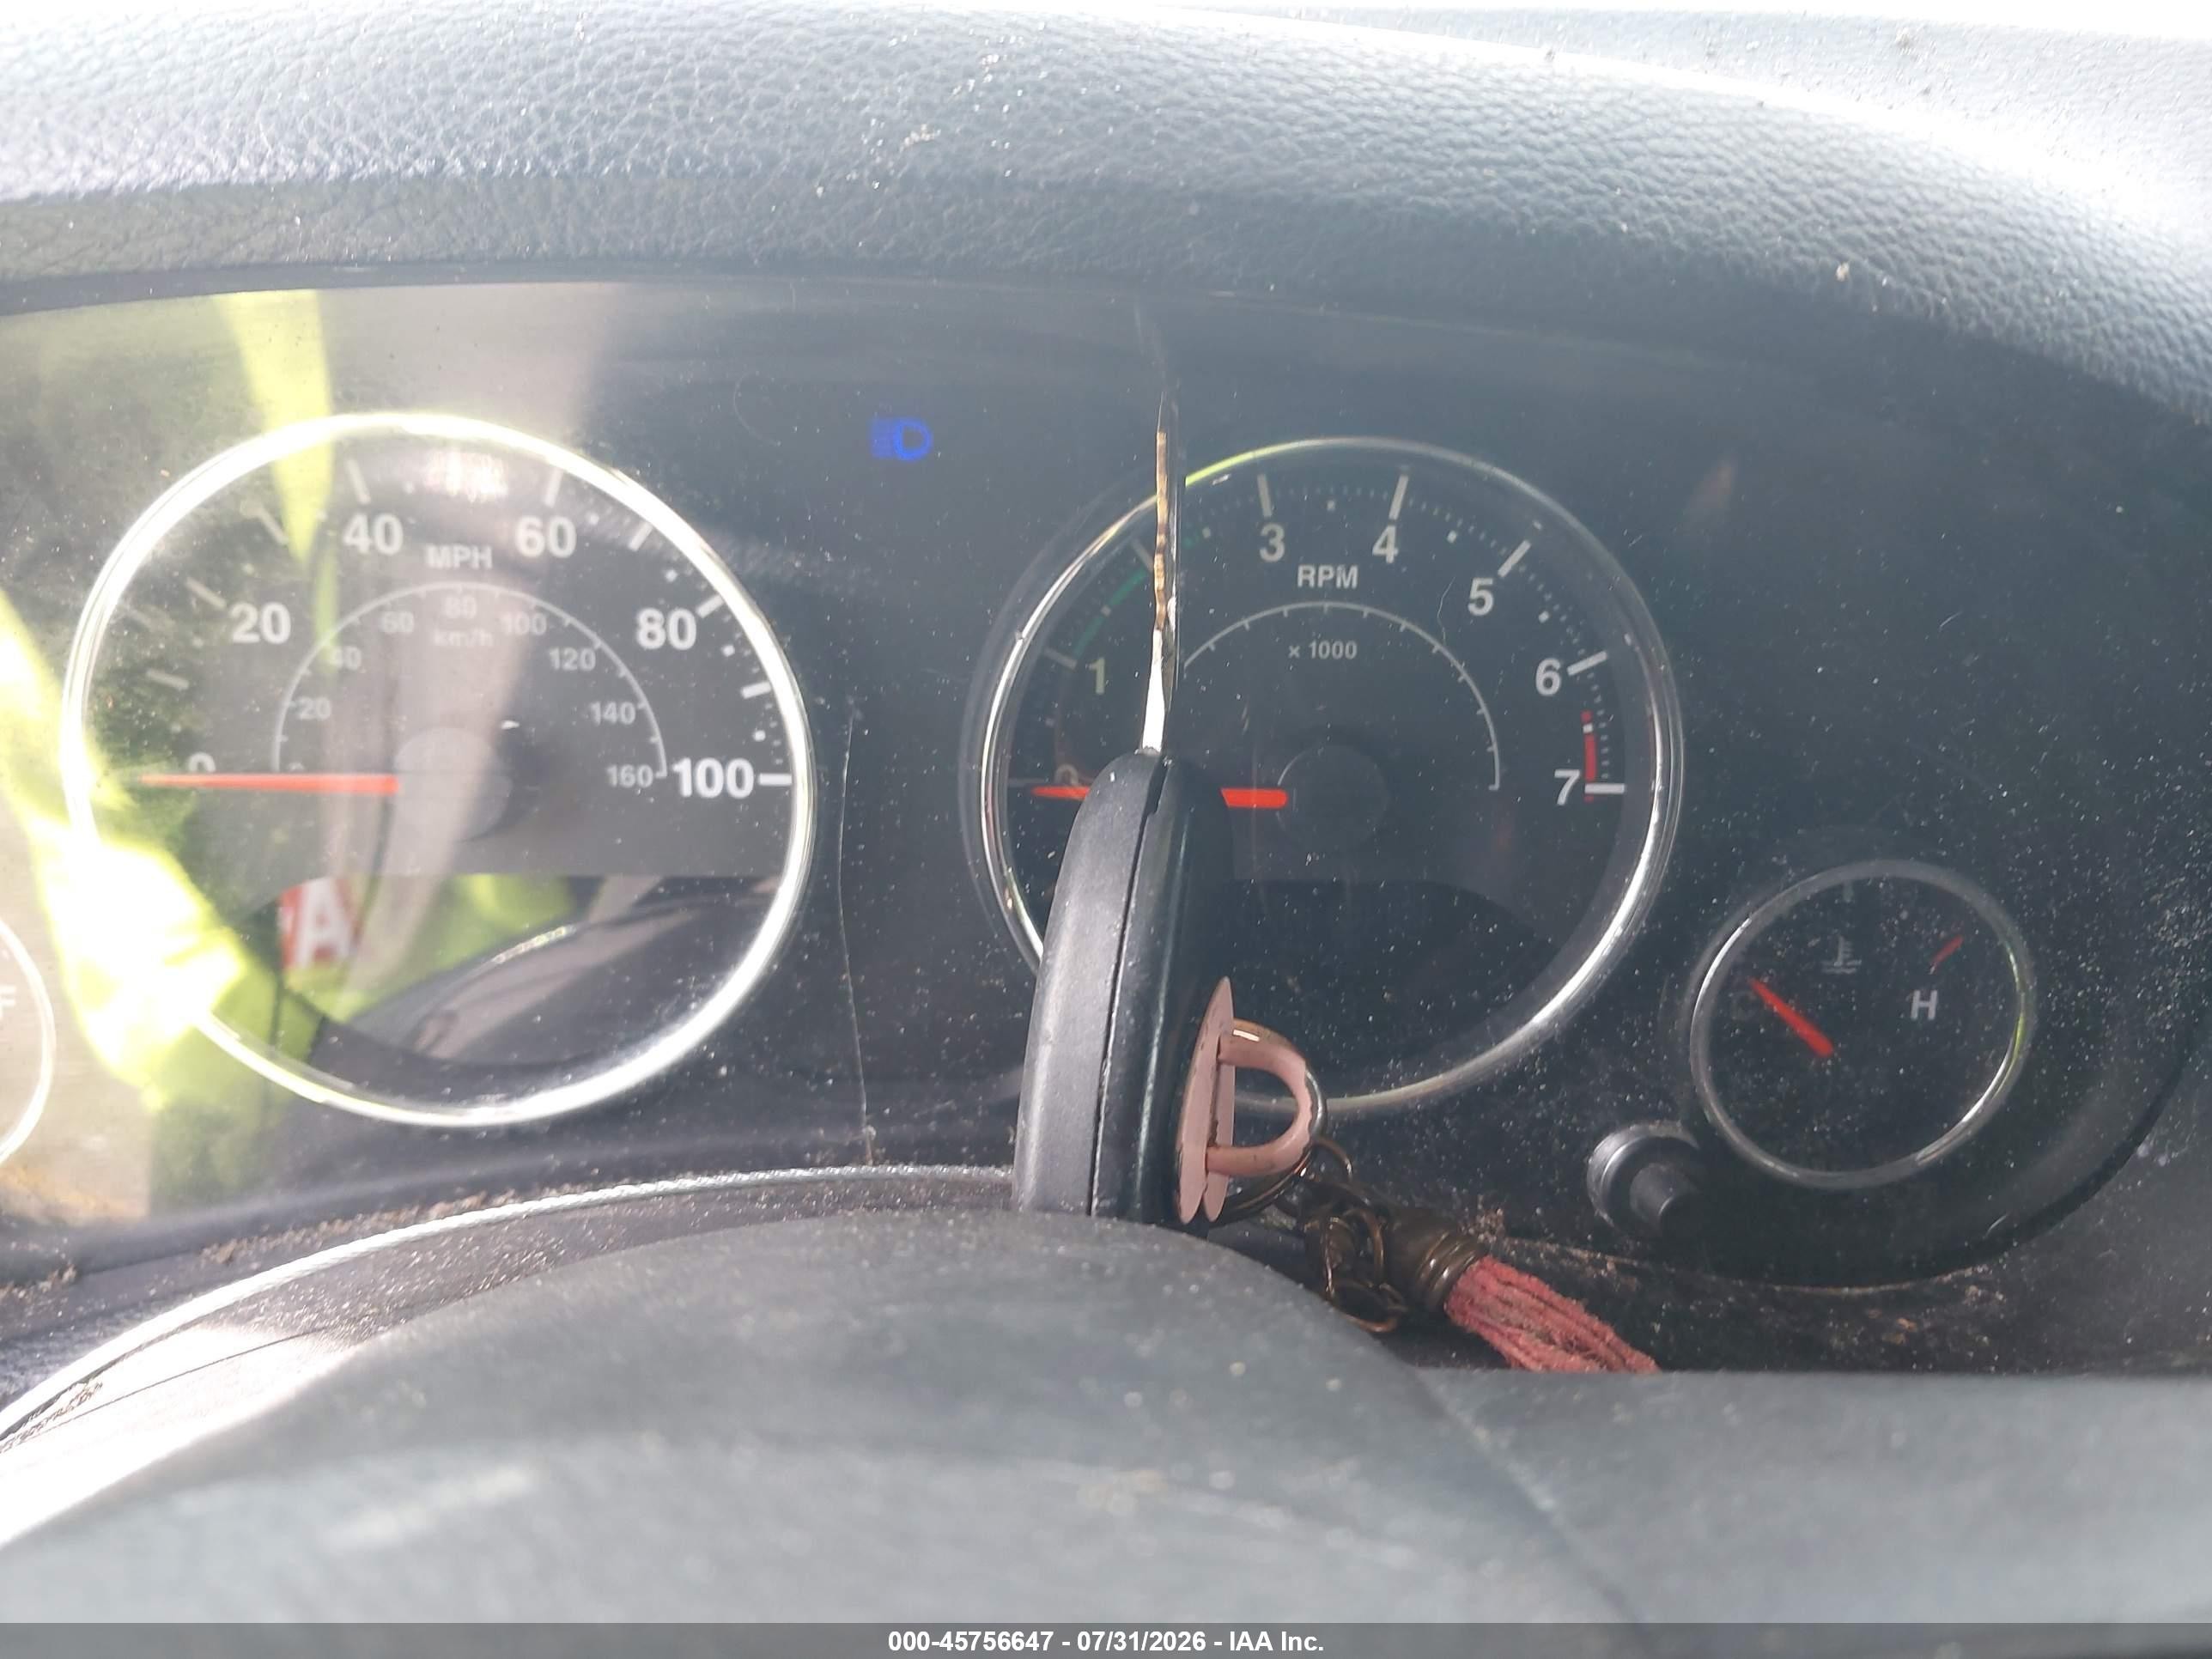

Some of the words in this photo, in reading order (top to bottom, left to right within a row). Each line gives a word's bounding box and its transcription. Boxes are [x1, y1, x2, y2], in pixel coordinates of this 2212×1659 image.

[344, 514, 403, 556] 40
[515, 516, 577, 558] 60
[1260, 523, 1285, 562] 3
[1371, 525, 1399, 564] 4
[426, 544, 493, 570] MPH
[1297, 564, 1358, 588] RPM
[444, 596, 477, 618] 80
[1468, 577, 1494, 617] 5
[230, 602, 292, 644] 20
[381, 611, 414, 634] 60
[501, 612, 546, 636] 100
[636, 607, 696, 650] 80
[434, 628, 494, 648] km/h
[1309, 641, 1358, 659] 1000
[330, 646, 362, 670] 40
[549, 648, 595, 671] 120
[1089, 657, 1106, 695] 1
[1535, 658, 1561, 696] 6
[297, 697, 331, 720] 20
[591, 702, 636, 725] 140
[607, 764, 653, 787] 160
[672, 757, 754, 799] 100
[1554, 769, 1580, 805] 7
[1911, 989, 1938, 1020] H
